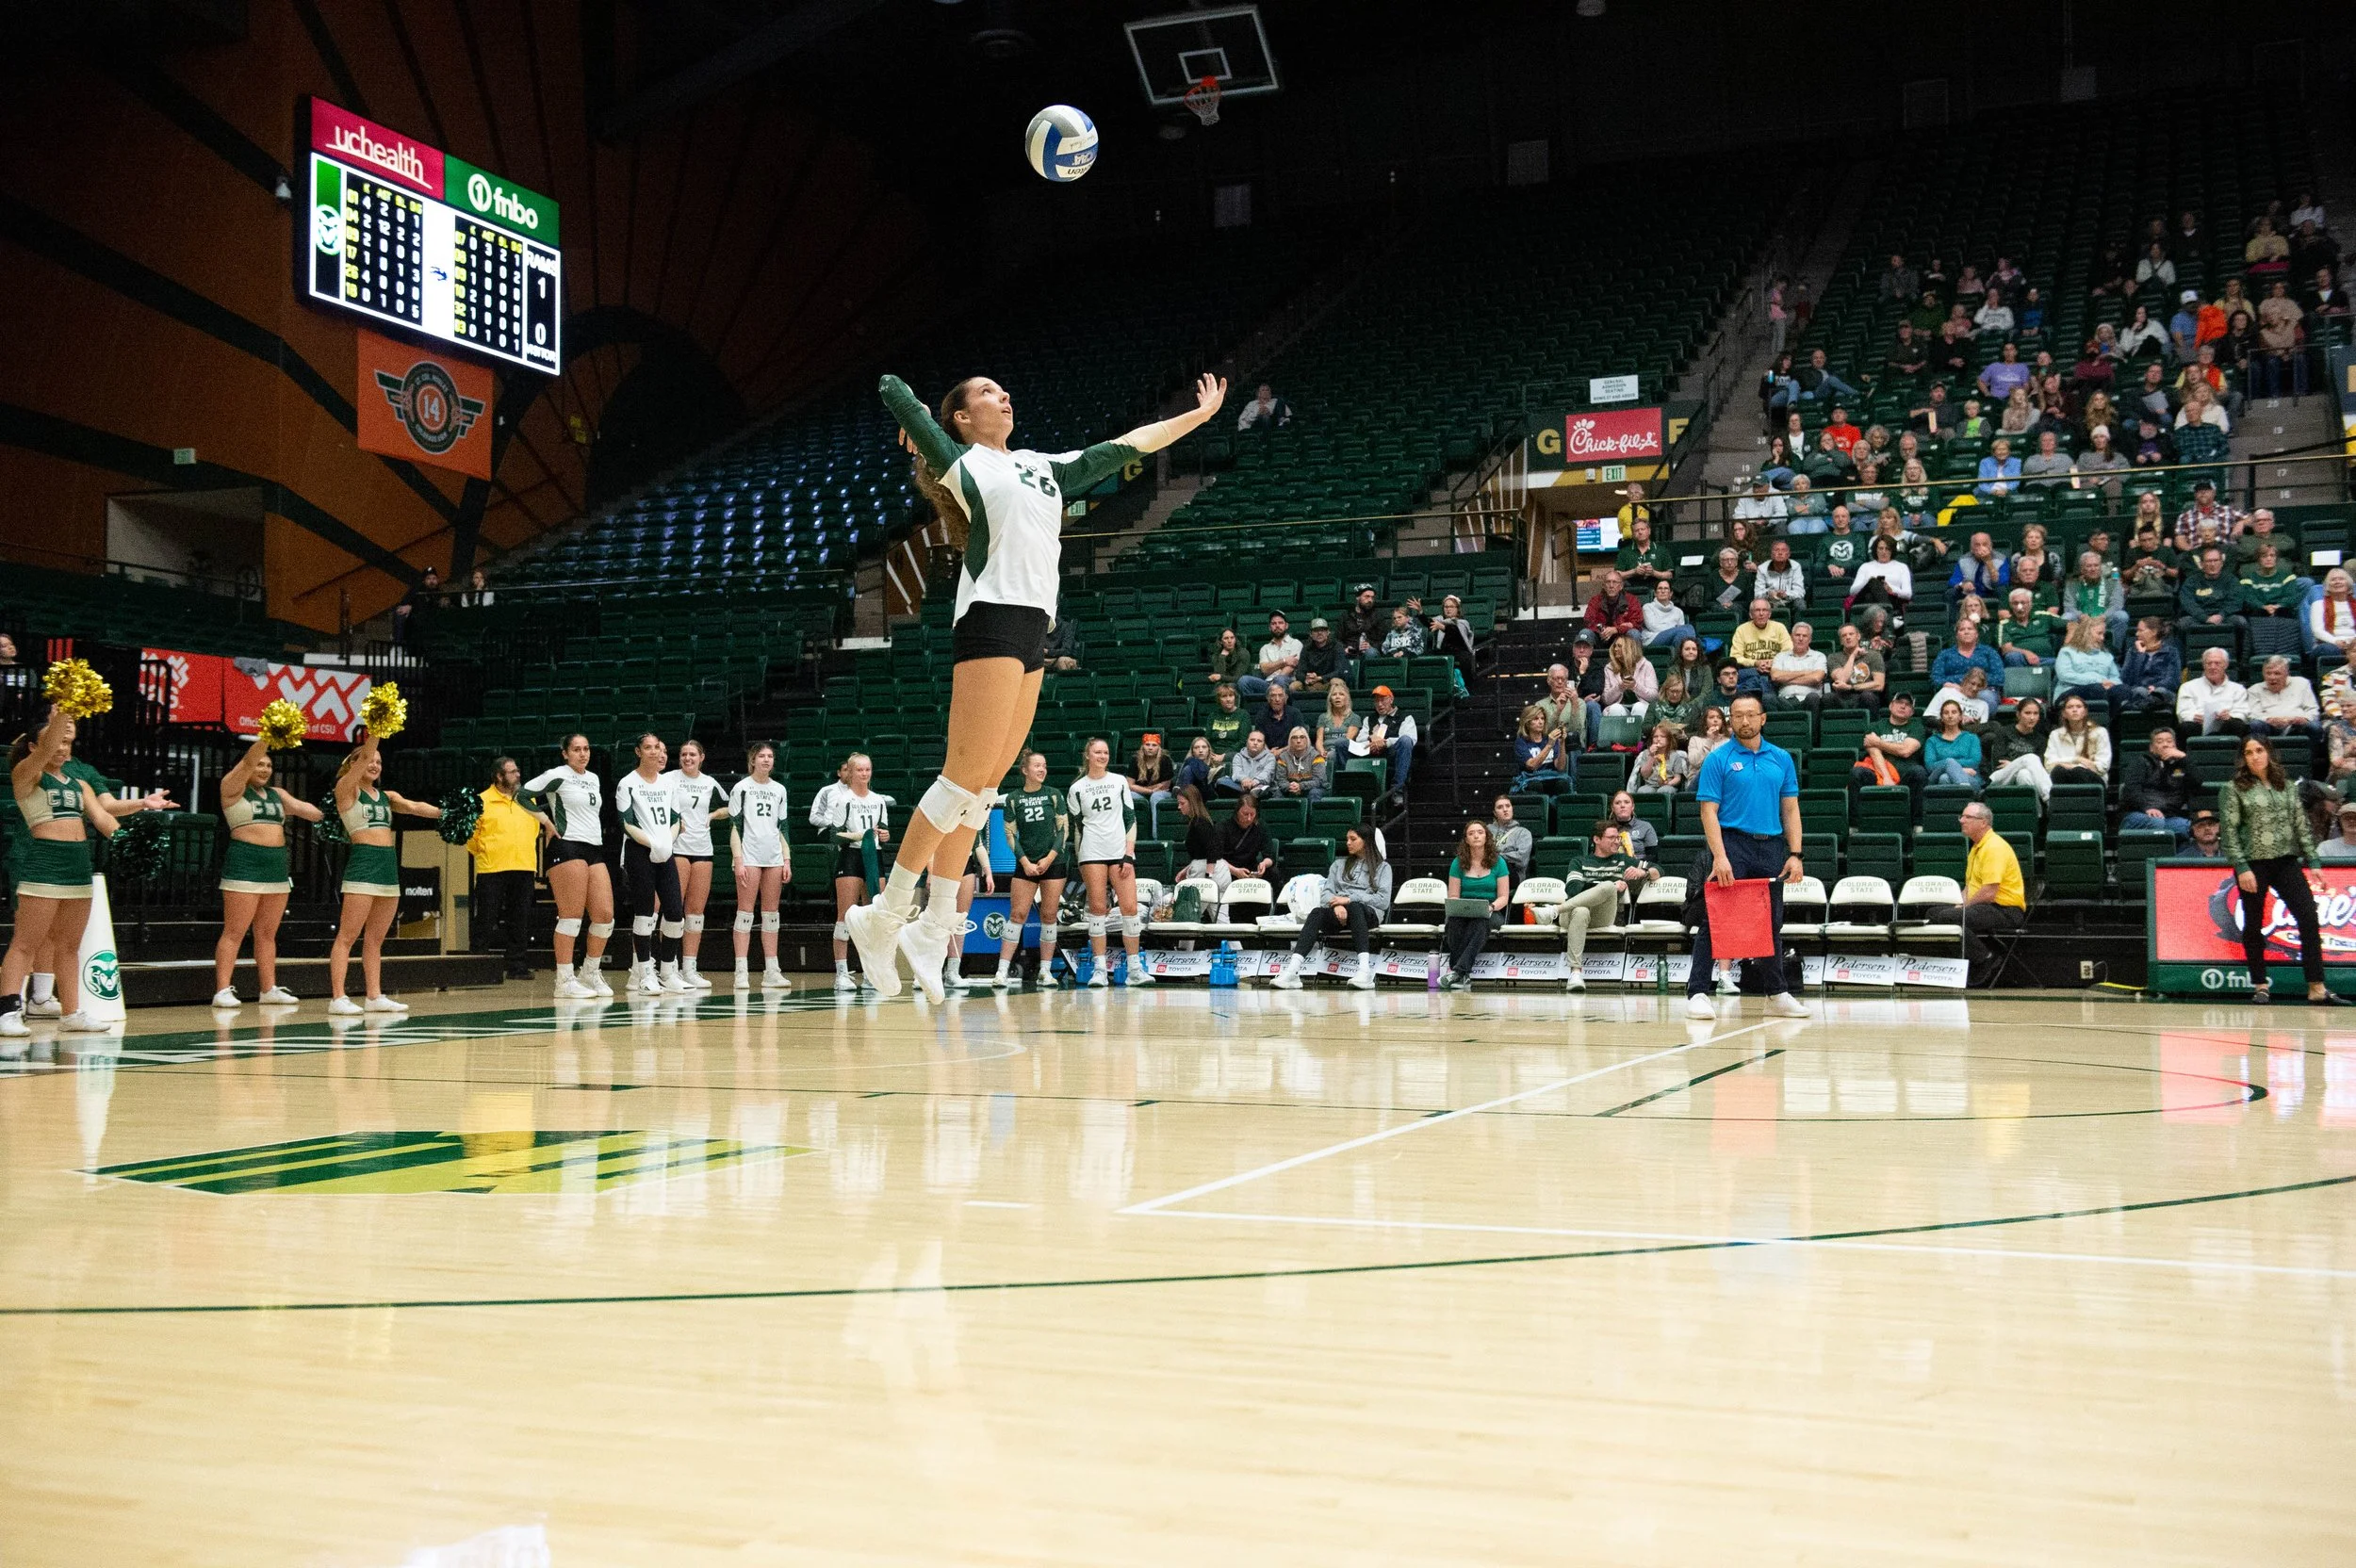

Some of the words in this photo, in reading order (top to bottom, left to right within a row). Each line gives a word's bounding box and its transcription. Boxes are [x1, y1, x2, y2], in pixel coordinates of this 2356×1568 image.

[335, 125, 424, 182] uchealth
[380, 202, 388, 217] 2
[413, 215, 420, 228] 1
[494, 187, 538, 230] fnbo
[364, 213, 371, 228] 2
[398, 226, 405, 241] 2
[413, 232, 420, 247] 2
[363, 232, 371, 247] 2
[484, 242, 492, 256] 3
[499, 249, 507, 262] 2
[515, 254, 520, 267] 1
[364, 251, 369, 265] 1
[398, 263, 403, 277] 1
[471, 254, 477, 268] 1
[514, 271, 520, 285] 2
[471, 271, 477, 285] 1
[469, 288, 477, 303] 2
[537, 277, 546, 299] 1
[381, 294, 386, 307] 1
[470, 307, 477, 320] 1
[485, 330, 491, 342] 1
[514, 339, 519, 351] 1
[535, 322, 547, 345] 0
[424, 396, 440, 422] 14
[1668, 417, 1690, 445] F
[1536, 428, 1561, 455] G
[1606, 467, 1623, 481] EXIT
[1744, 640, 1782, 651] COLORADO
[1751, 651, 1774, 660] STATE
[239, 716, 260, 728] Offici
[320, 725, 335, 735] CSU
[1086, 784, 1114, 793] COLORADO
[692, 795, 699, 808] 7
[1019, 795, 1048, 804] COLORADO
[1091, 796, 1112, 812] 42
[650, 807, 667, 825] 13
[757, 803, 771, 816] 23
[1024, 807, 1044, 822] 22
[860, 814, 873, 829] 11
[405, 887, 434, 896] molten
[1152, 952, 1202, 963] Pedersen
[1500, 954, 1557, 967] Pedersen
[1830, 956, 1891, 971] Pedersen
[1900, 957, 1962, 972] Pedersen
